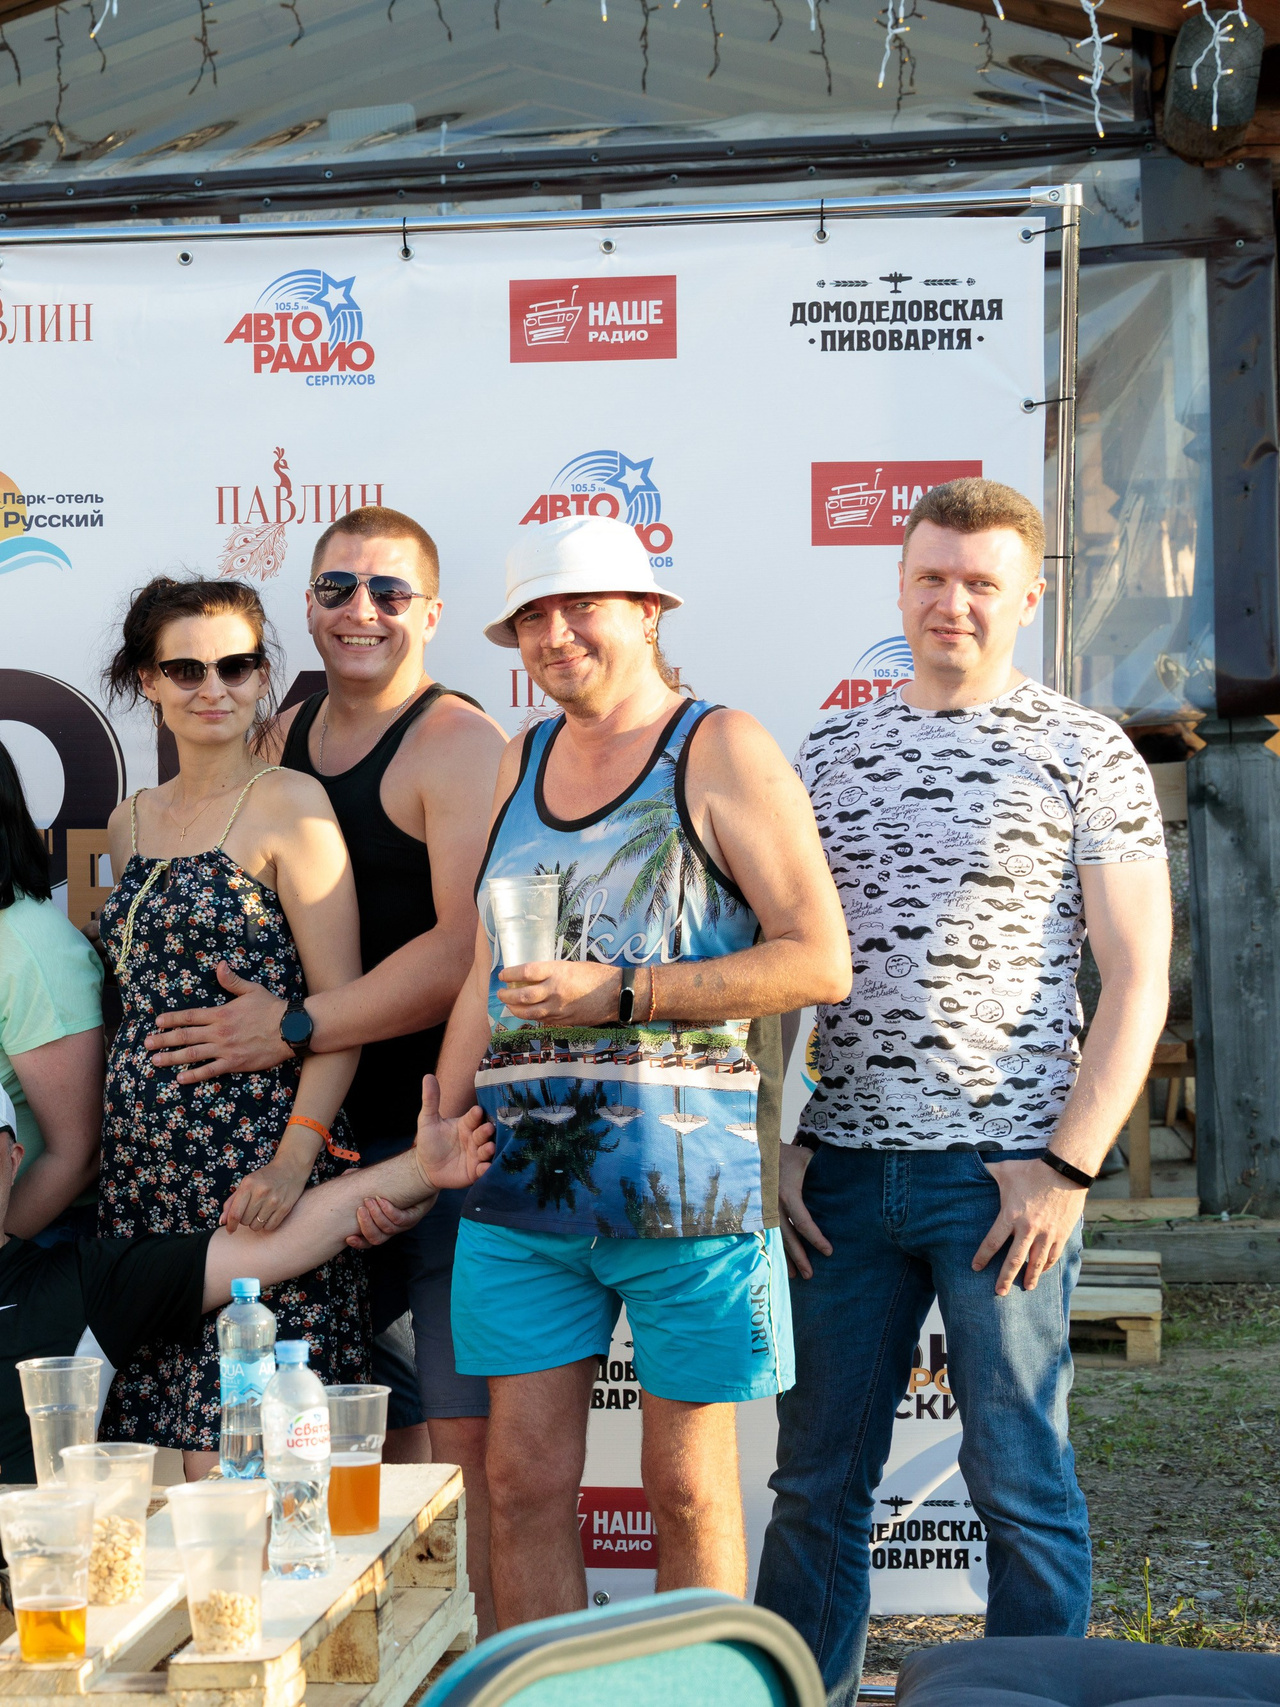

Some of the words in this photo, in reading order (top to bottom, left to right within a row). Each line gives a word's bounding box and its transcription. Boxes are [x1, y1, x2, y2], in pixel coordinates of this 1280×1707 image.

[275, 302, 300, 311] 105.5
[588, 300, 663, 326] НАШЕ
[790, 299, 1003, 327] ДОМОДЕДОВСКАЯ
[223, 311, 323, 344] АВТО
[588, 330, 649, 343] РАДИО
[820, 328, 972, 351] ПИВОВАРНЯ
[253, 340, 375, 374] РАДИО
[306, 374, 376, 386] СЕРПУХОВ
[571, 484, 596, 492] 105.5
[3, 492, 104, 507] Парк-отель
[518, 493, 620, 525] АВТО
[3, 510, 104, 532] Русский
[873, 669, 899, 677] 105.5
[819, 679, 914, 710] АВТ
[750, 1284, 770, 1356] SPORT
[593, 1540, 653, 1552] РАДИО
